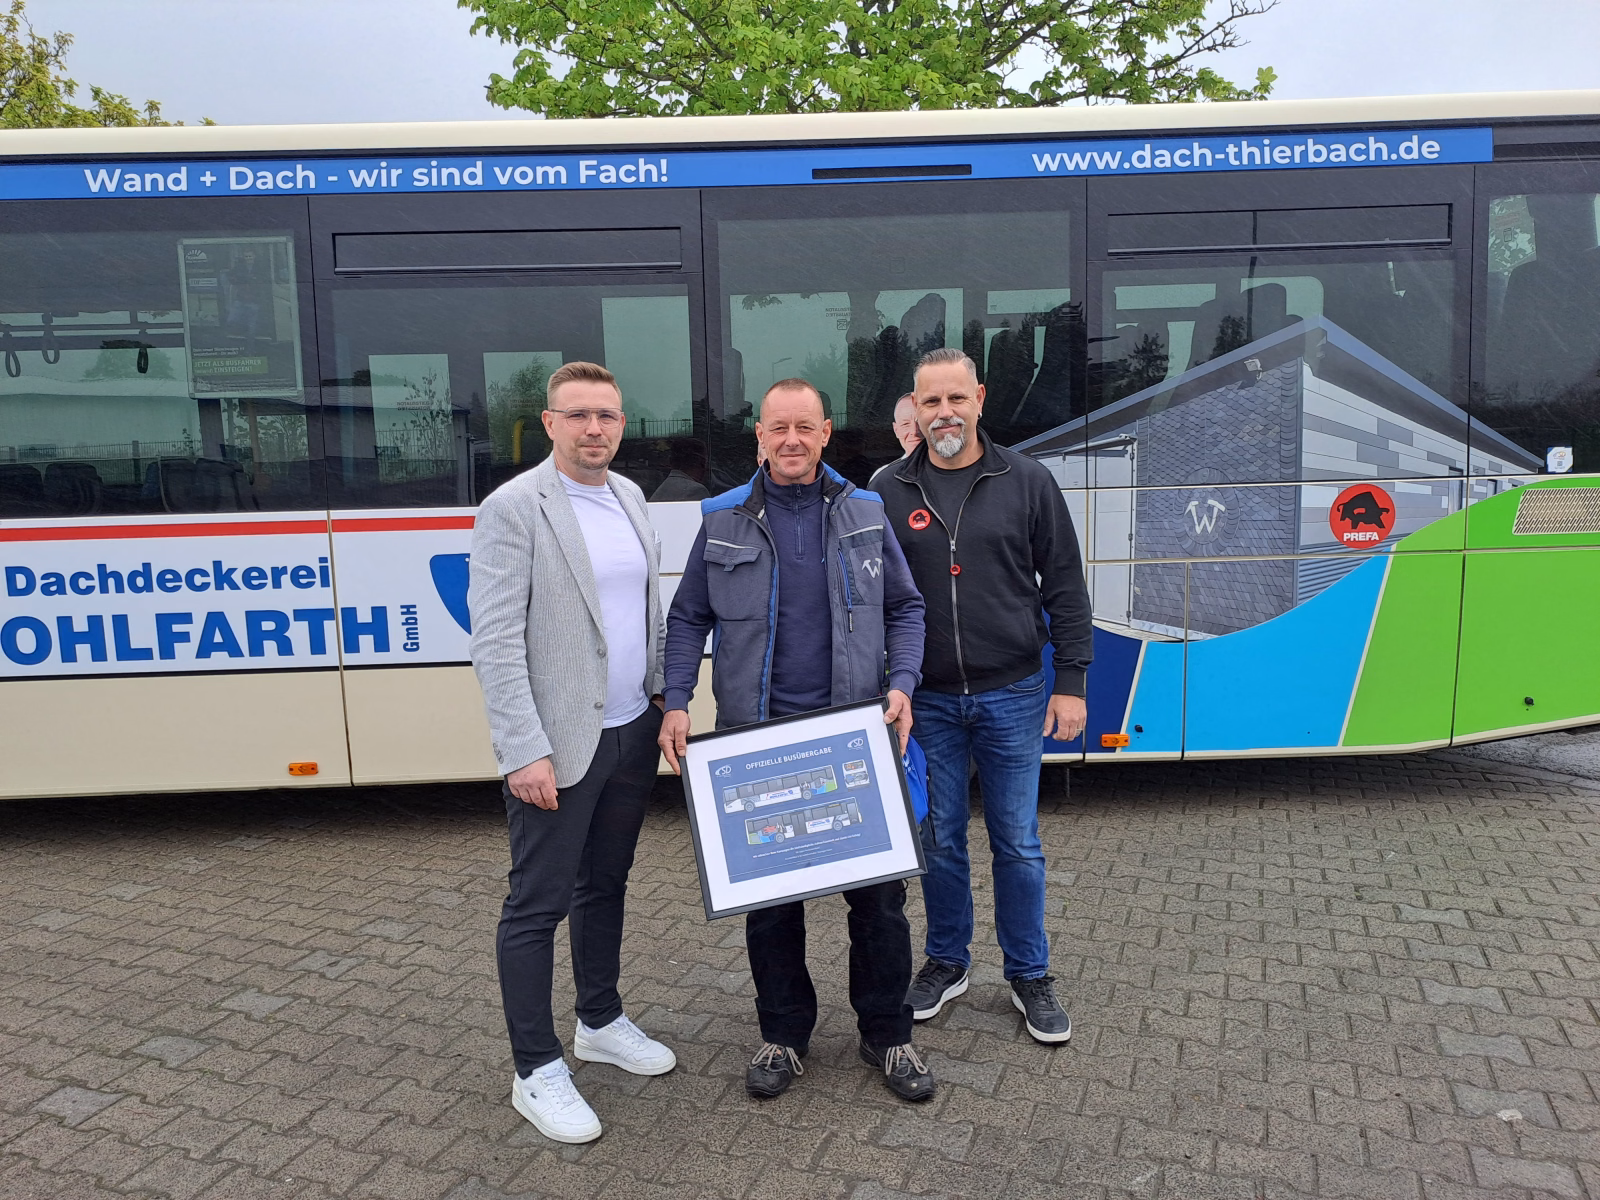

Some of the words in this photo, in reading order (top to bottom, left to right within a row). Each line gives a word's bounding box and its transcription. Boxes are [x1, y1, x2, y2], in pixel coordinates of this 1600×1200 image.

[1031, 134, 1441, 172] www.dach-thierbach.de
[84, 163, 188, 193] Wand
[199, 170, 218, 188] +
[229, 163, 316, 191] Dach
[347, 161, 403, 188] wir
[412, 159, 484, 187] sind
[493, 165, 567, 185] vom
[579, 157, 669, 184] Fach!
[225, 359, 262, 367] BUSFAHRER
[1343, 531, 1380, 542] PREFA
[5, 556, 331, 597] Dachdeckerei
[400, 604, 420, 653] GmbH
[745, 756, 783, 770] OFFIZIELLE
[783, 746, 833, 763] BUSÜBERGABE
